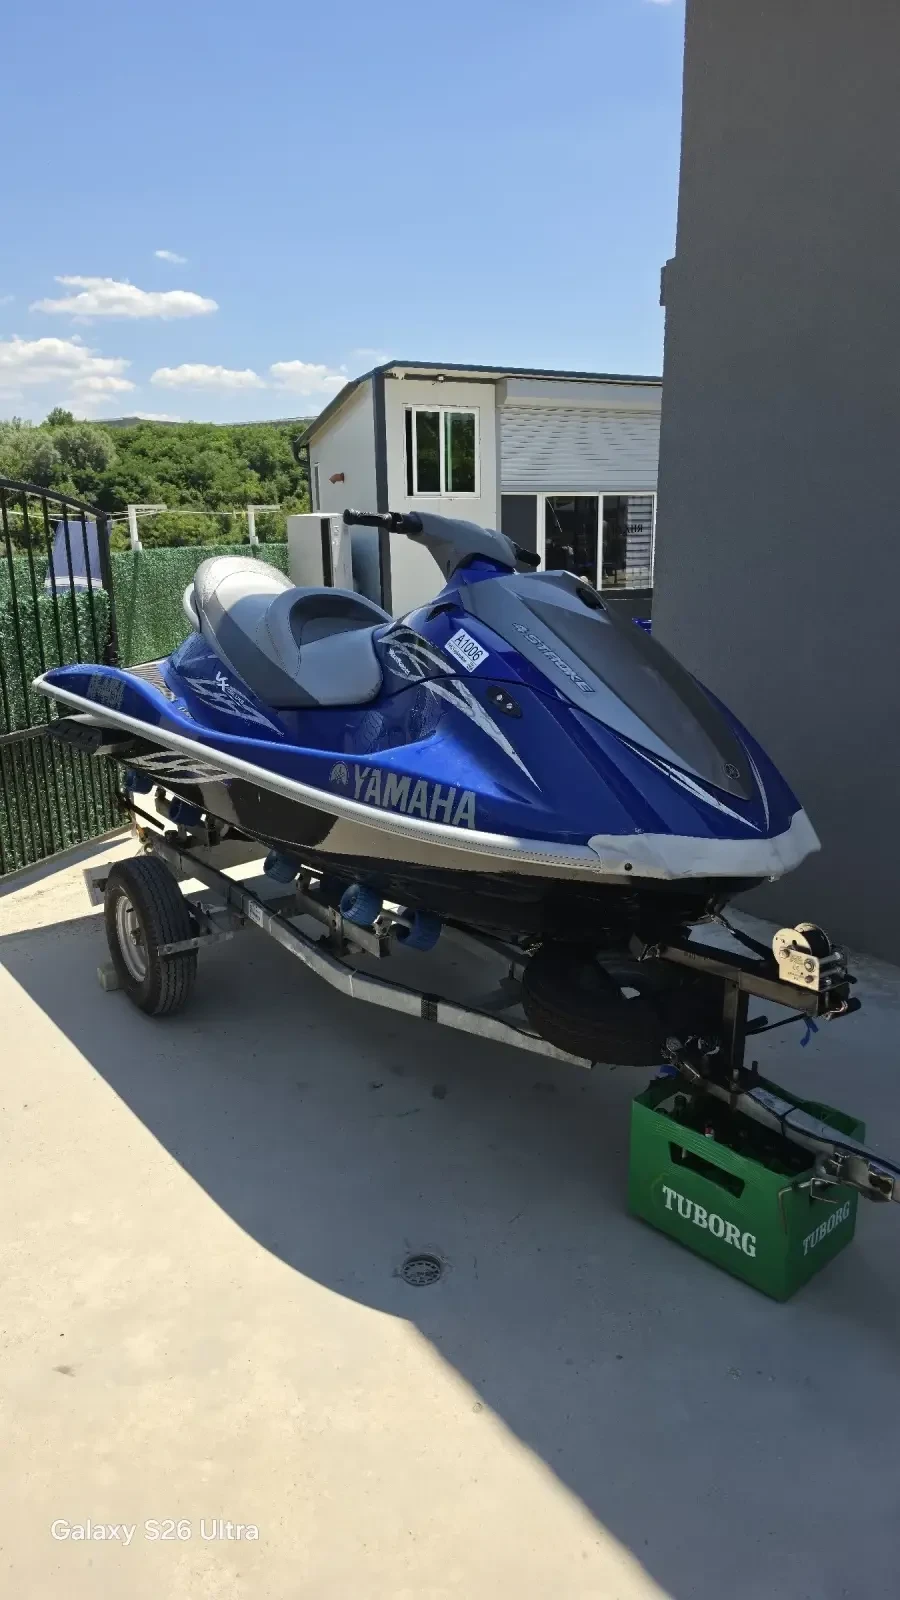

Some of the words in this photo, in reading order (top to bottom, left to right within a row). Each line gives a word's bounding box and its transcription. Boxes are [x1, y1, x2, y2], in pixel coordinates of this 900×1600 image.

[455, 634, 484, 661] A1006
[354, 764, 476, 829] YAMAHA
[662, 1184, 757, 1258] TUBORG
[803, 1201, 850, 1256] TUBORG
